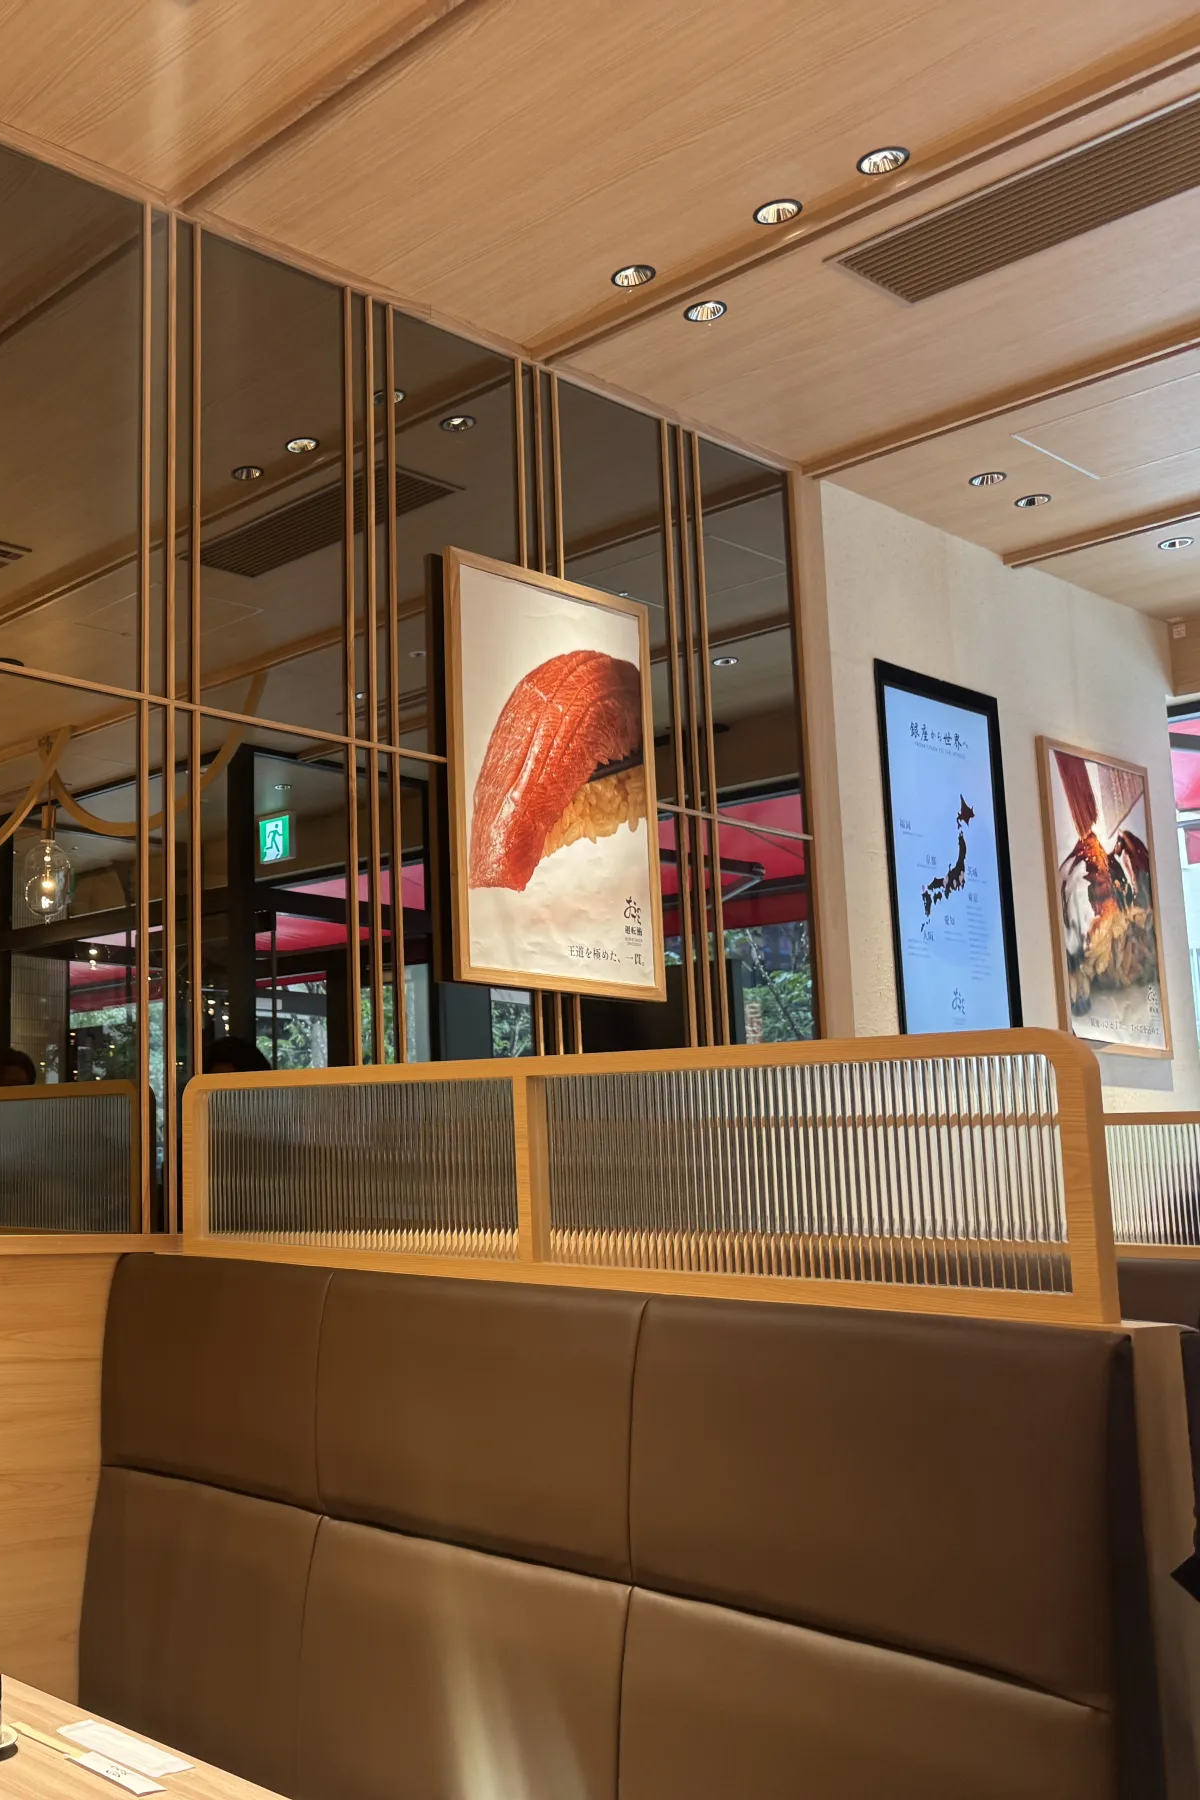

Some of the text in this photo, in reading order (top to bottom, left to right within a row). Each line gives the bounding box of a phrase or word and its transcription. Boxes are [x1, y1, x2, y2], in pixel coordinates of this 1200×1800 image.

[910, 721, 968, 751] 銀座から世界へ
